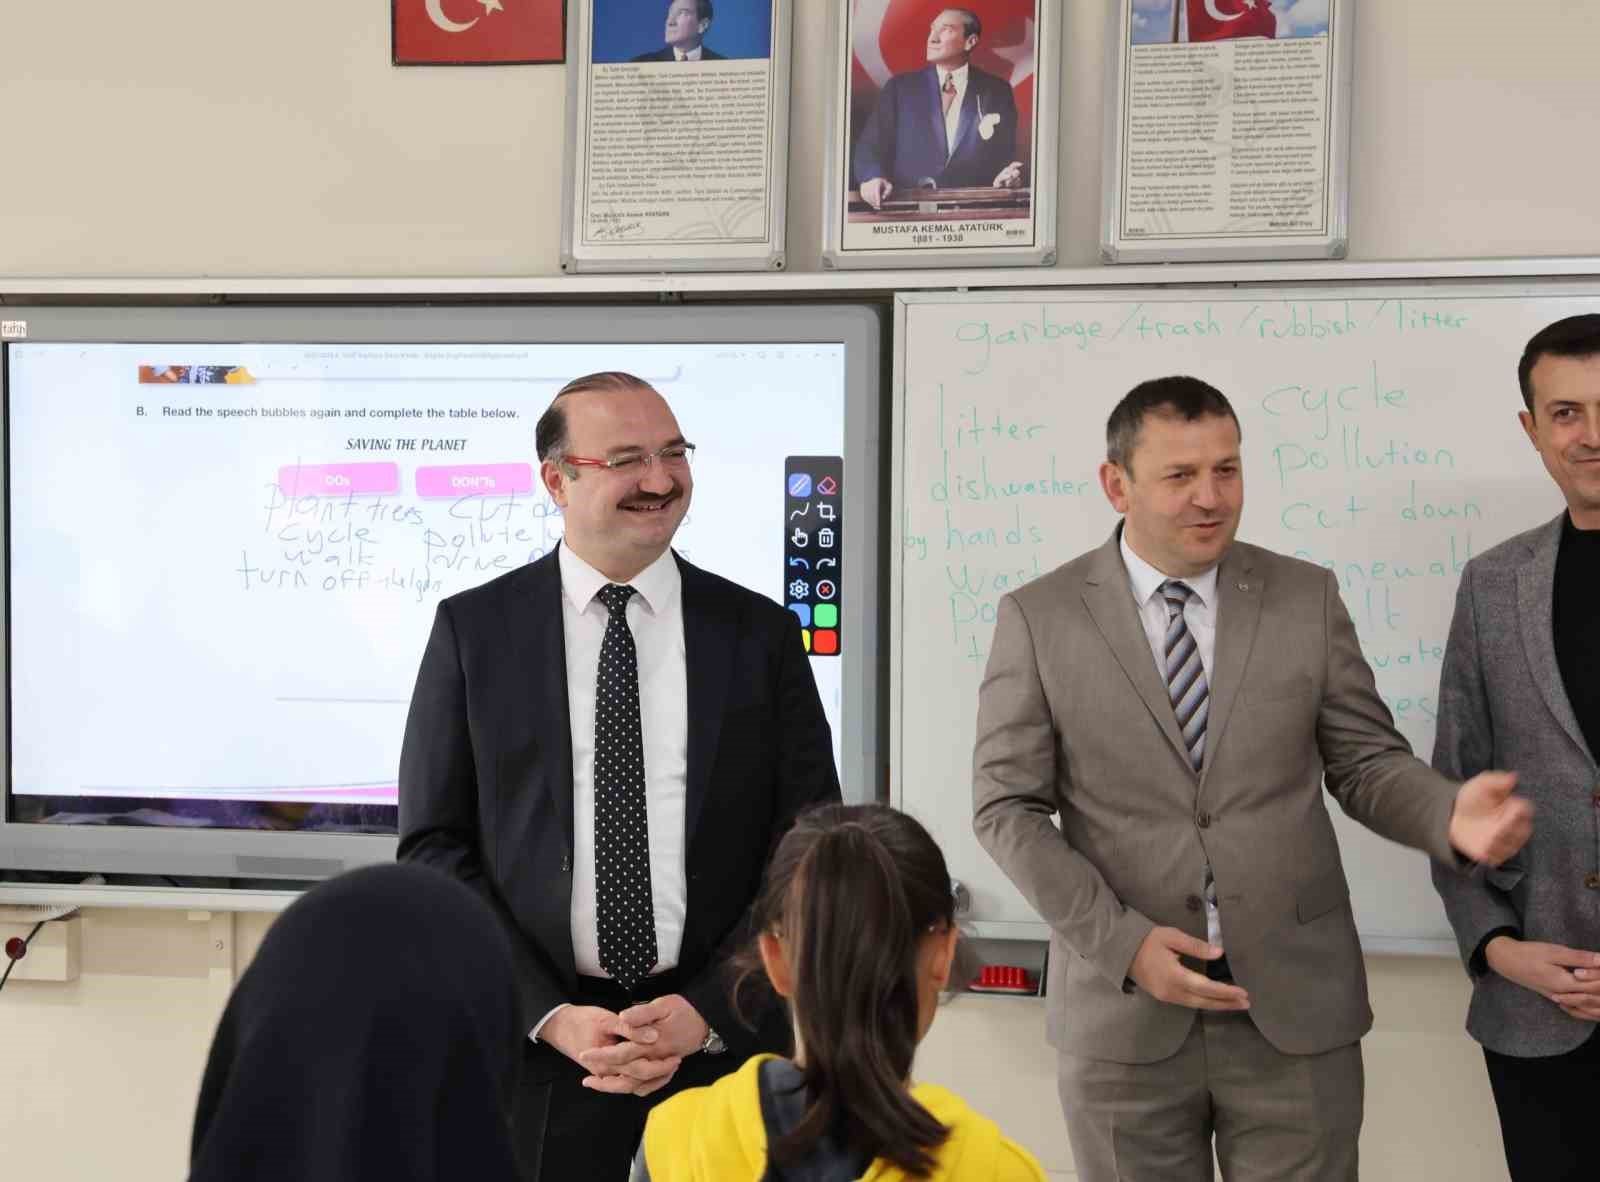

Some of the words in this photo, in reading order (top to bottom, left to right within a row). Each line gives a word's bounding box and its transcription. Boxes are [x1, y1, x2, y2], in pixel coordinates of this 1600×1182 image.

[872, 225, 919, 234] MUSTAFA
[922, 224, 954, 233] KEMAL
[942, 233, 964, 243] 1938
[136, 406, 148, 417] B.
[162, 406, 192, 417] Read
[195, 406, 213, 417] the
[217, 407, 258, 419] speech
[261, 407, 307, 418] bubbles
[309, 408, 341, 420] again
[344, 407, 366, 418] and
[369, 407, 423, 420] complete
[427, 407, 445, 418] the
[448, 407, 478, 418] table
[481, 407, 520, 418] below.
[937, 383, 1047, 449] litter
[1261, 359, 1409, 441] cycle
[345, 438, 392, 451] SAVING
[395, 438, 417, 451] THE
[420, 438, 467, 451] PLANET
[1273, 423, 1456, 489] pollution
[930, 448, 1090, 503] dishwasher
[945, 503, 1043, 551] hands
